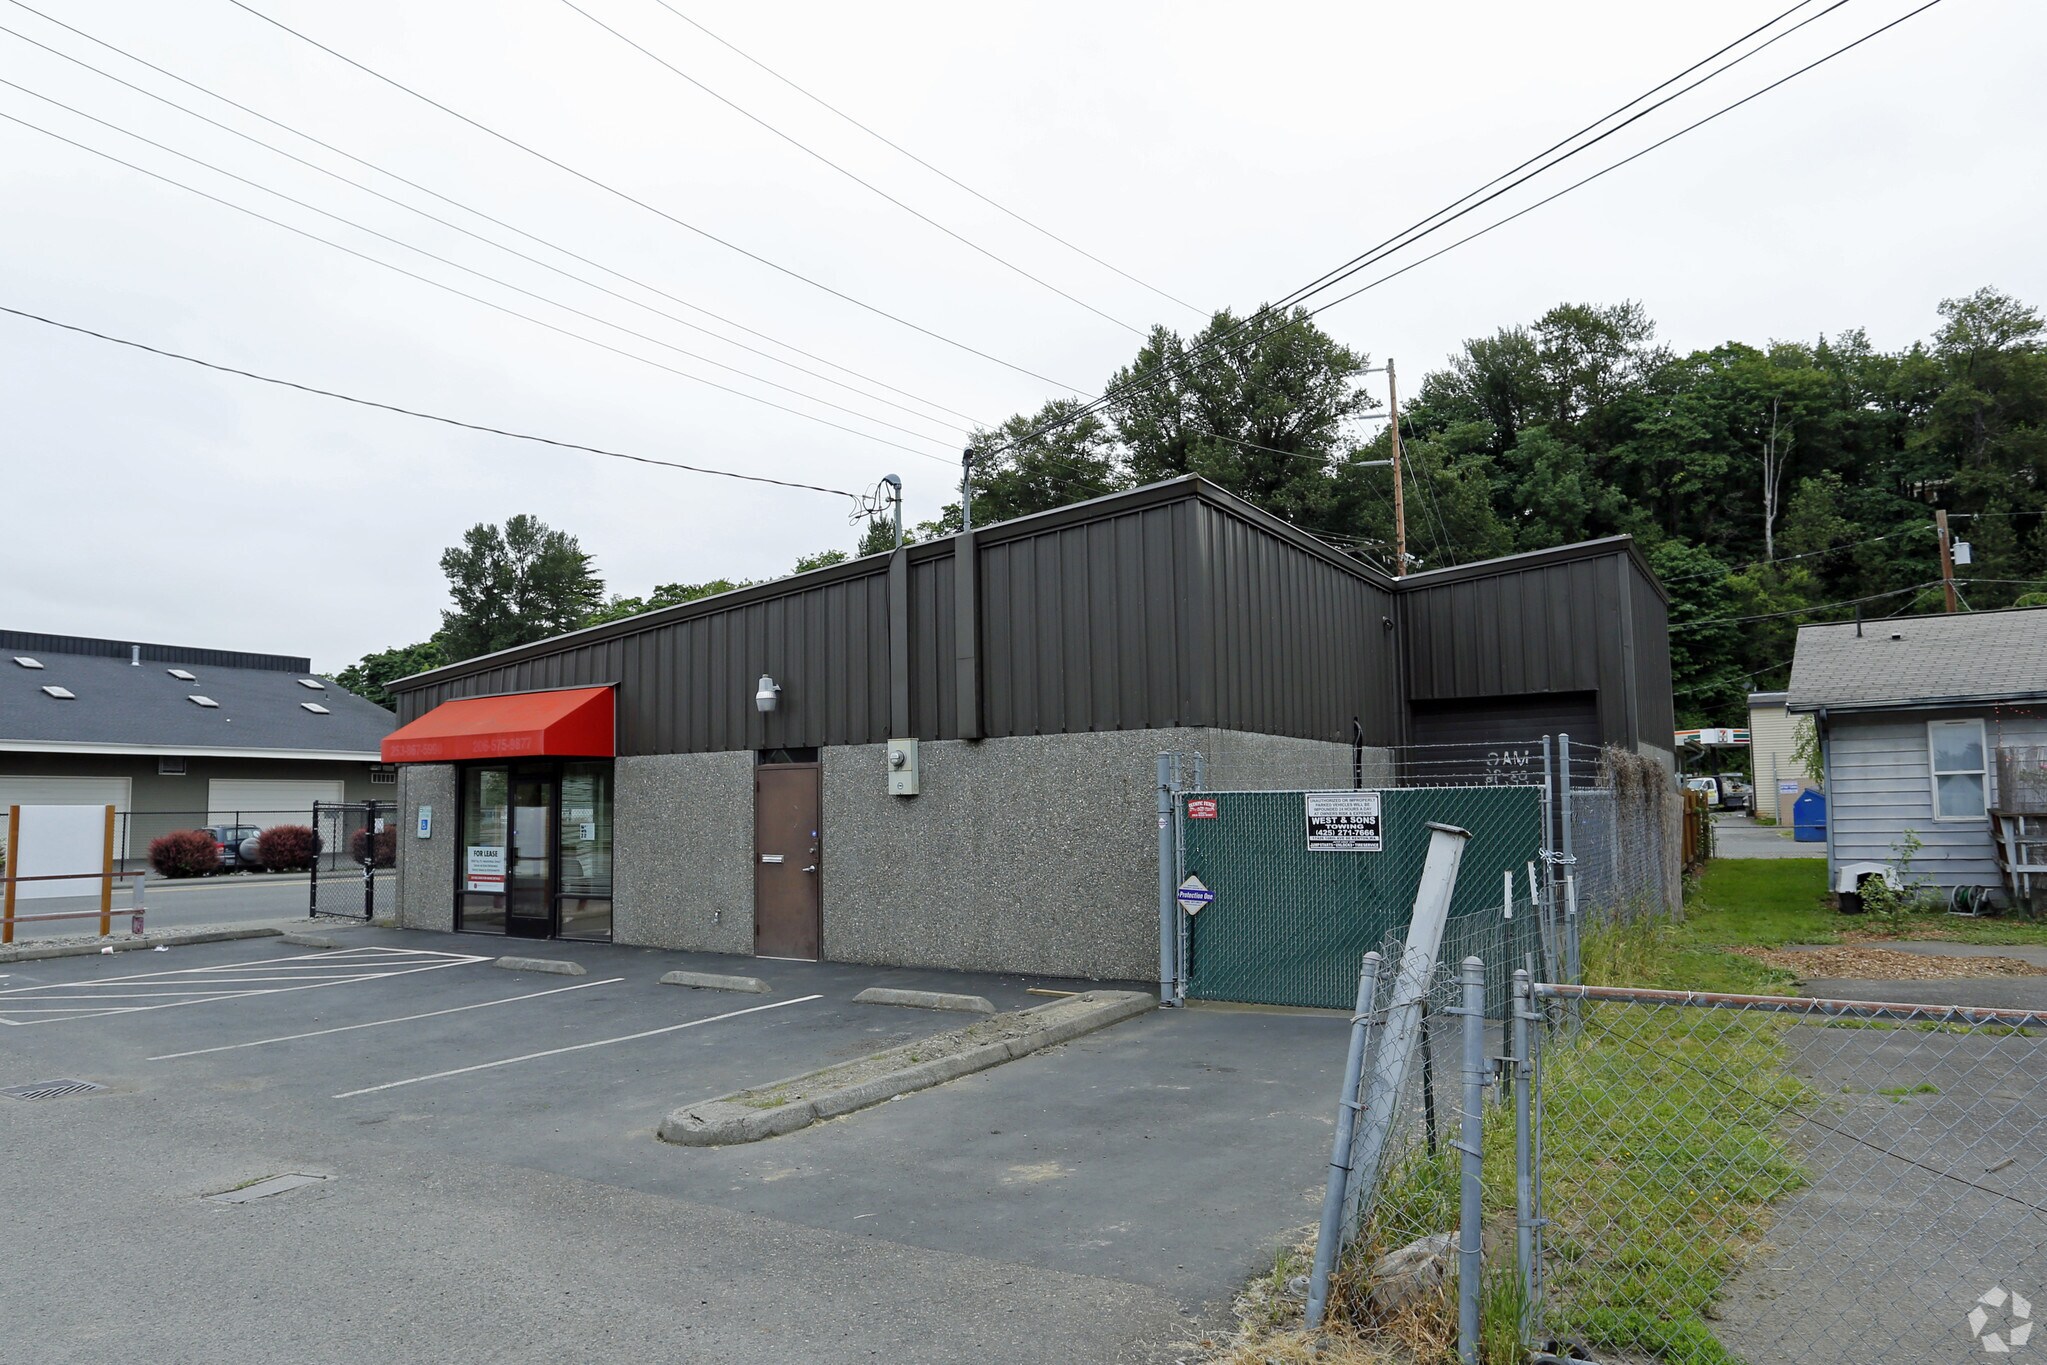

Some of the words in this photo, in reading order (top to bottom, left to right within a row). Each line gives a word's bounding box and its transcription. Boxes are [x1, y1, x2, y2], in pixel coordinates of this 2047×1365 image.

[1311, 816, 1338, 825] WEST
[1340, 816, 1347, 824] &
[1350, 816, 1376, 825] SONS
[1179, 891, 1203, 899] Protection
[1203, 892, 1214, 900] One
